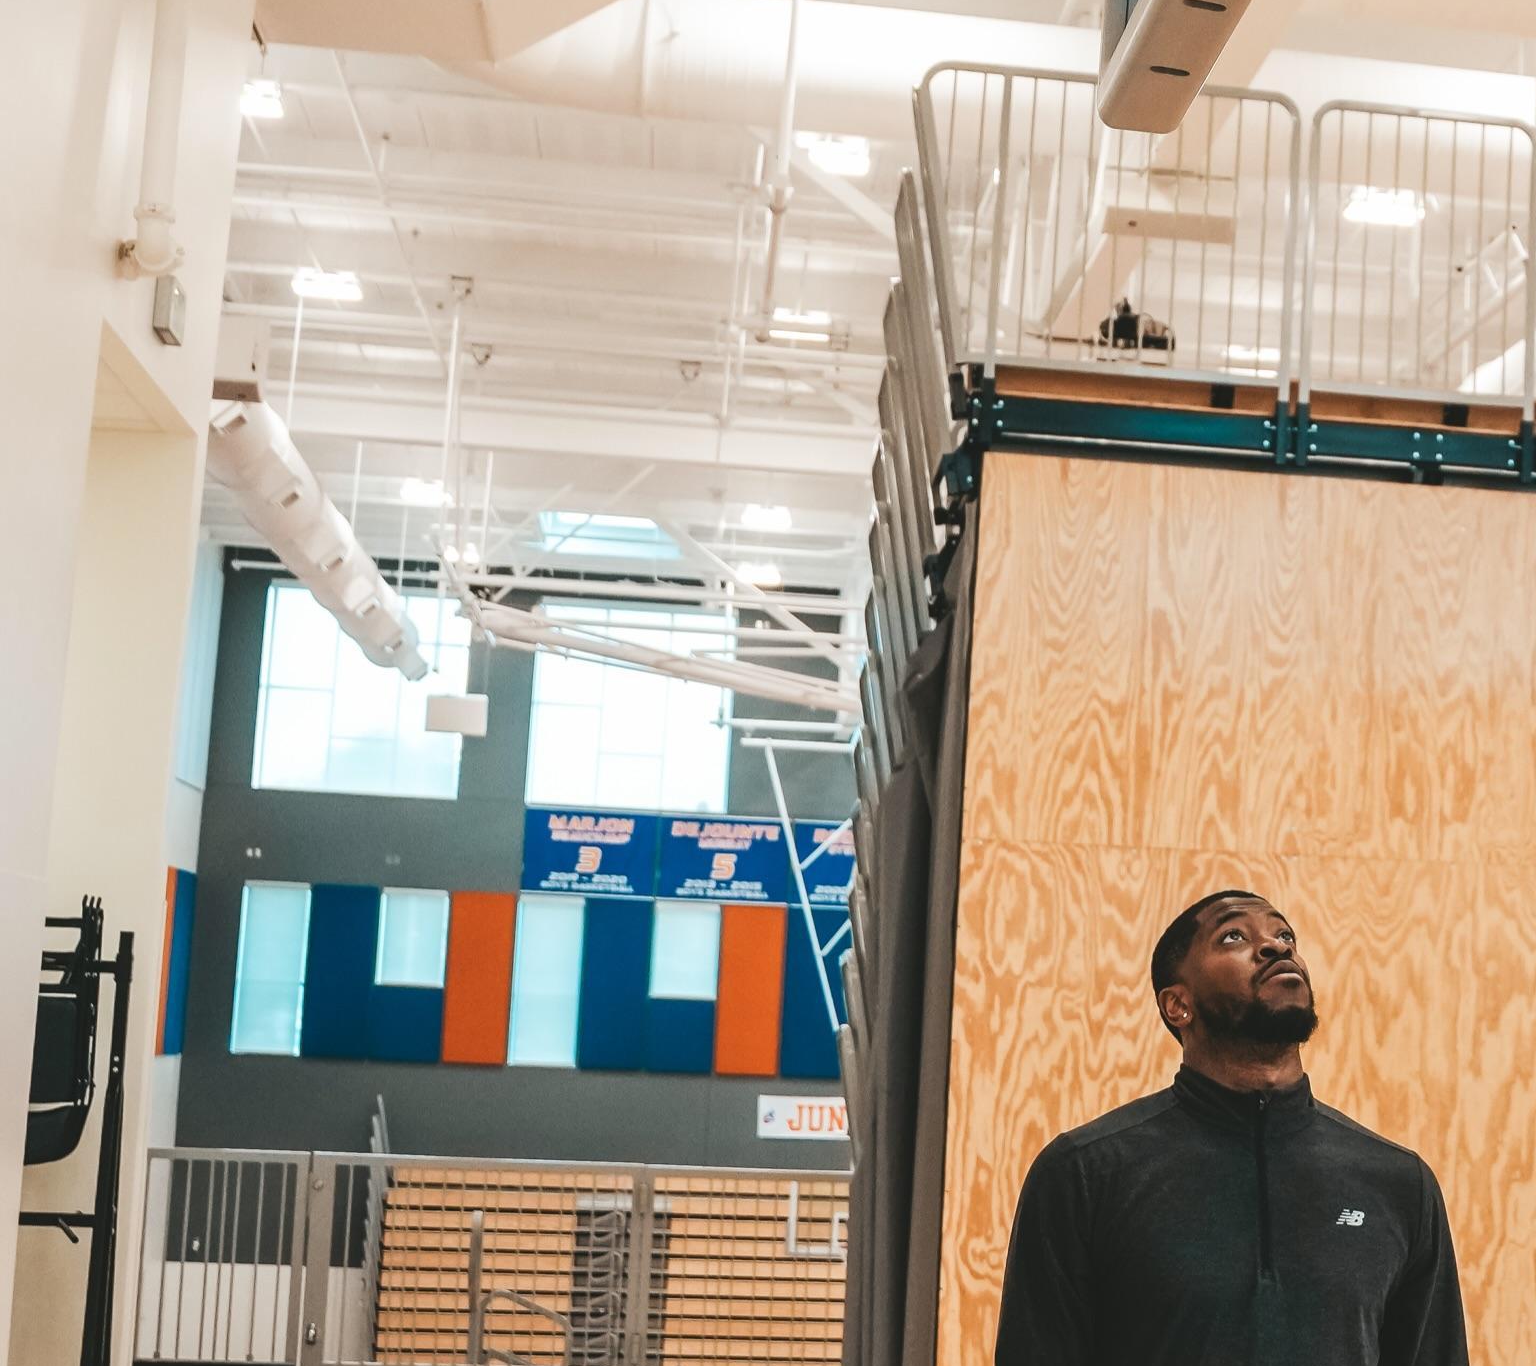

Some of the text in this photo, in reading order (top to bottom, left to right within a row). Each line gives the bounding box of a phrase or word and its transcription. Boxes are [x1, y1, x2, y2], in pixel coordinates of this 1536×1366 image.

[575, 845, 602, 873] 3
[710, 852, 738, 880] 5
[1336, 1208, 1365, 1226] NB
